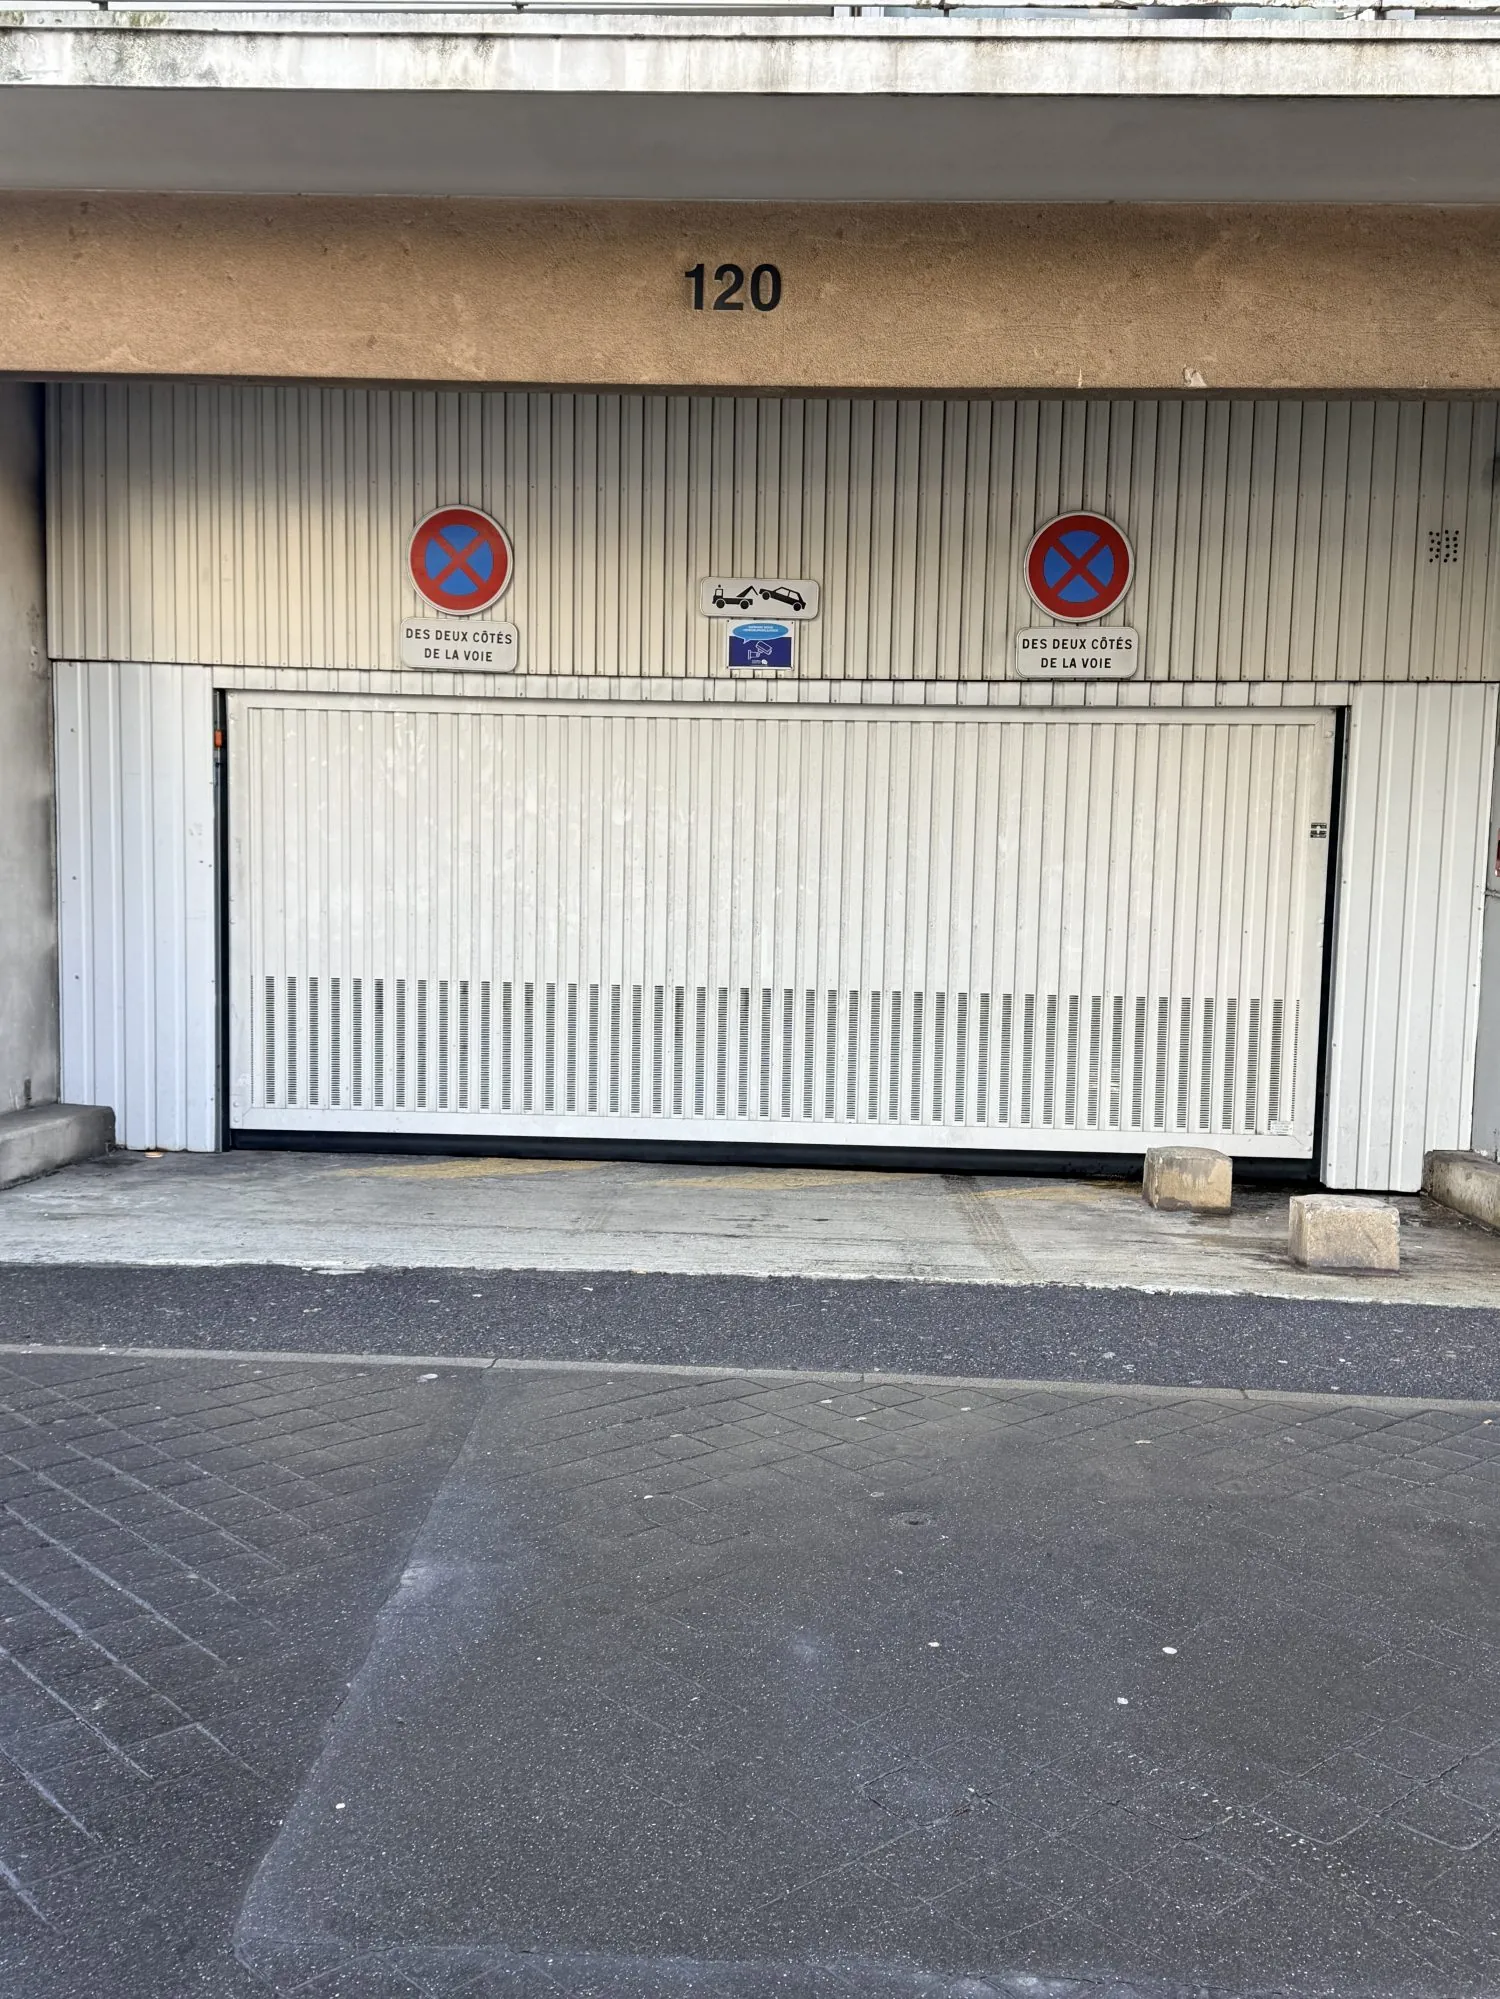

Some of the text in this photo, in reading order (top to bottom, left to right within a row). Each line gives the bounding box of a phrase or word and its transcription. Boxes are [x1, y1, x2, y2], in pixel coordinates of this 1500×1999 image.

[685, 263, 781, 311] 120
[406, 628, 512, 645] DES DEUX CÔTÉS
[1022, 636, 1133, 650] DES DEUX CÔTÉS
[424, 648, 493, 662] DE LA VOIE
[1041, 657, 1112, 669] DE LA VOIE
